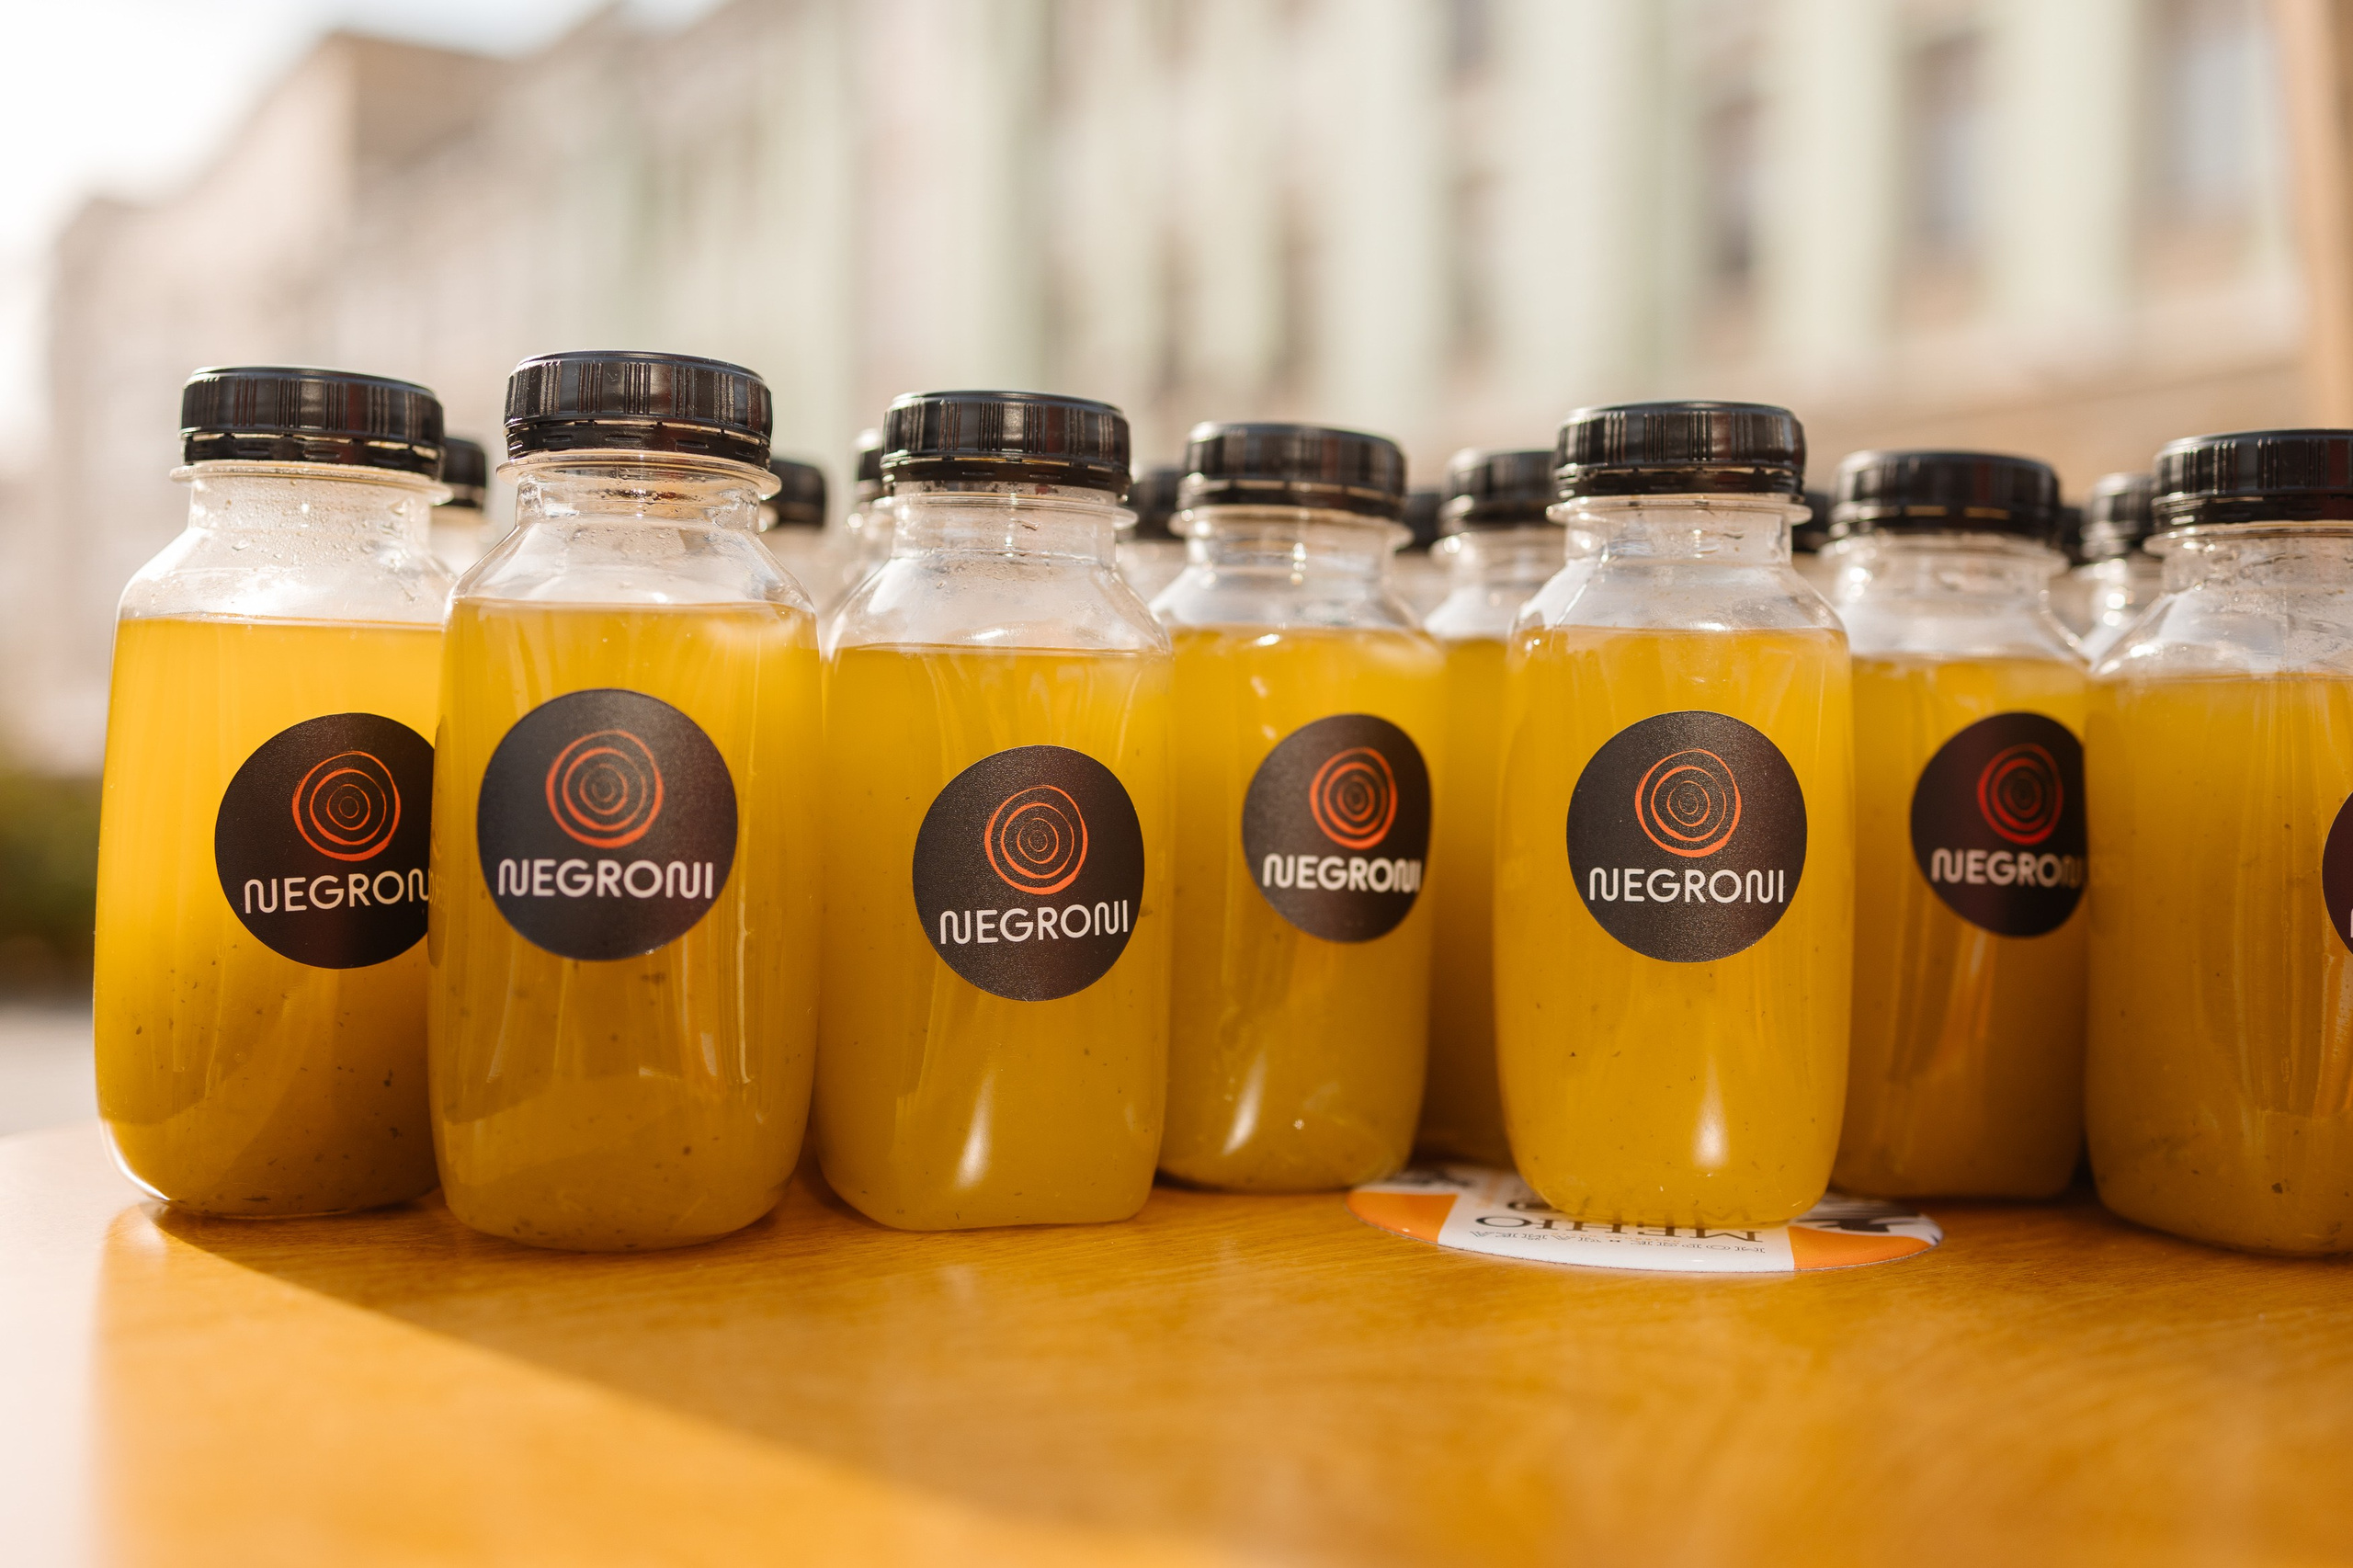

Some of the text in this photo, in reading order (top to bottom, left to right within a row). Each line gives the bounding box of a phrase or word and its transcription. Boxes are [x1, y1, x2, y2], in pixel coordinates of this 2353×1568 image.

[244, 869, 429, 914] NEGRON
[497, 858, 714, 900] NEGRONI
[1262, 853, 1423, 893] NEGRONI
[1588, 866, 1785, 903] NEGRONI
[939, 899, 1129, 945] NEGRONI
